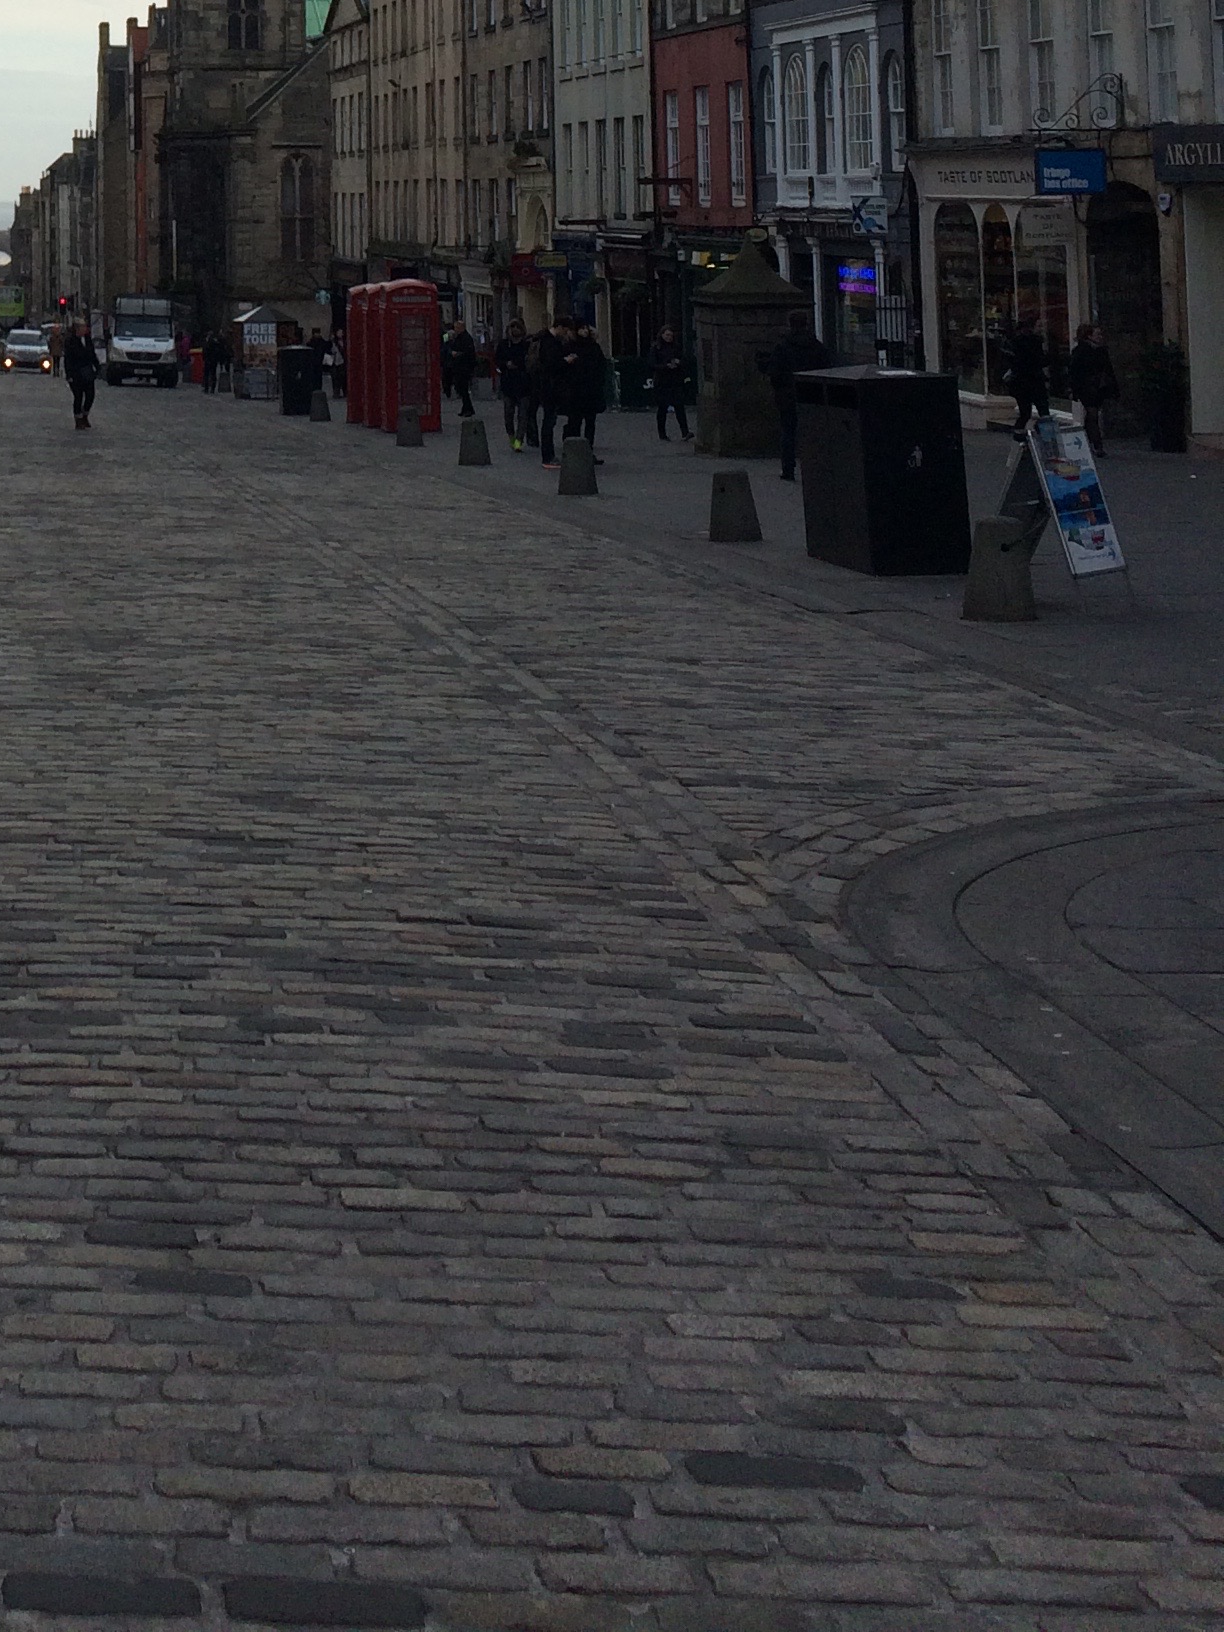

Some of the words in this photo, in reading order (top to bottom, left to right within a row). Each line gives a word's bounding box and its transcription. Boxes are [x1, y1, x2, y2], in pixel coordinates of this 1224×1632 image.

[938, 170, 966, 184] TASTE
[970, 170, 983, 184] OF
[986, 170, 1035, 184] SCOTLAN
[1043, 167, 1071, 179] fringe
[1043, 178, 1061, 189] box
[1061, 178, 1089, 189] office
[1025, 231, 1074, 239] SCOTLAND
[243, 323, 276, 335] FREE
[243, 334, 277, 345] TOUR
